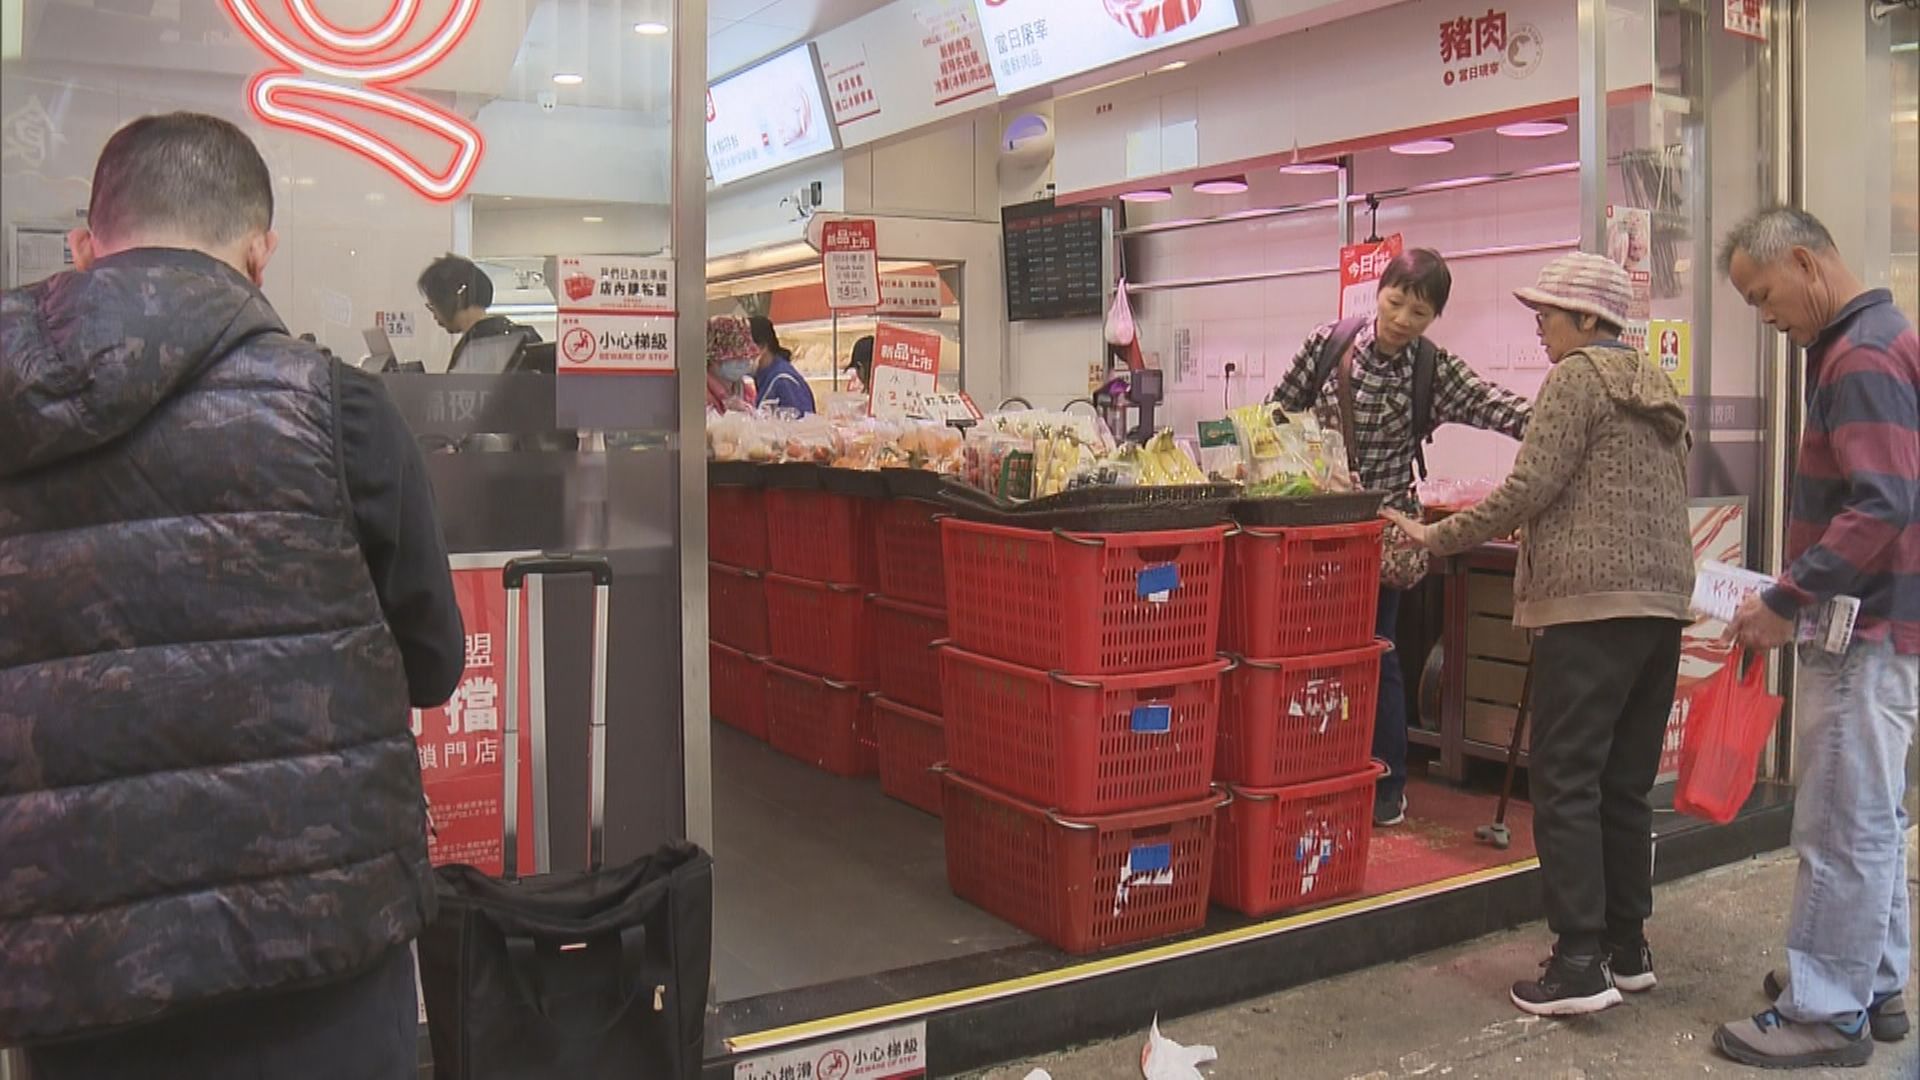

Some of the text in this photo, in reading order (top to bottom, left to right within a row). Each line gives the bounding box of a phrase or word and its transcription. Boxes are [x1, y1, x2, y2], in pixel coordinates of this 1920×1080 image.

[994, 17, 1049, 55] 當日屠宰
[1439, 8, 1508, 64] 豬肉
[599, 331, 668, 351] 小心梯級
[599, 353, 669, 361] BEWARE OF STEP
[853, 1037, 919, 1066] 小心梯級
[855, 1062, 887, 1075] BEWARE
[899, 1054, 918, 1065] STEP
